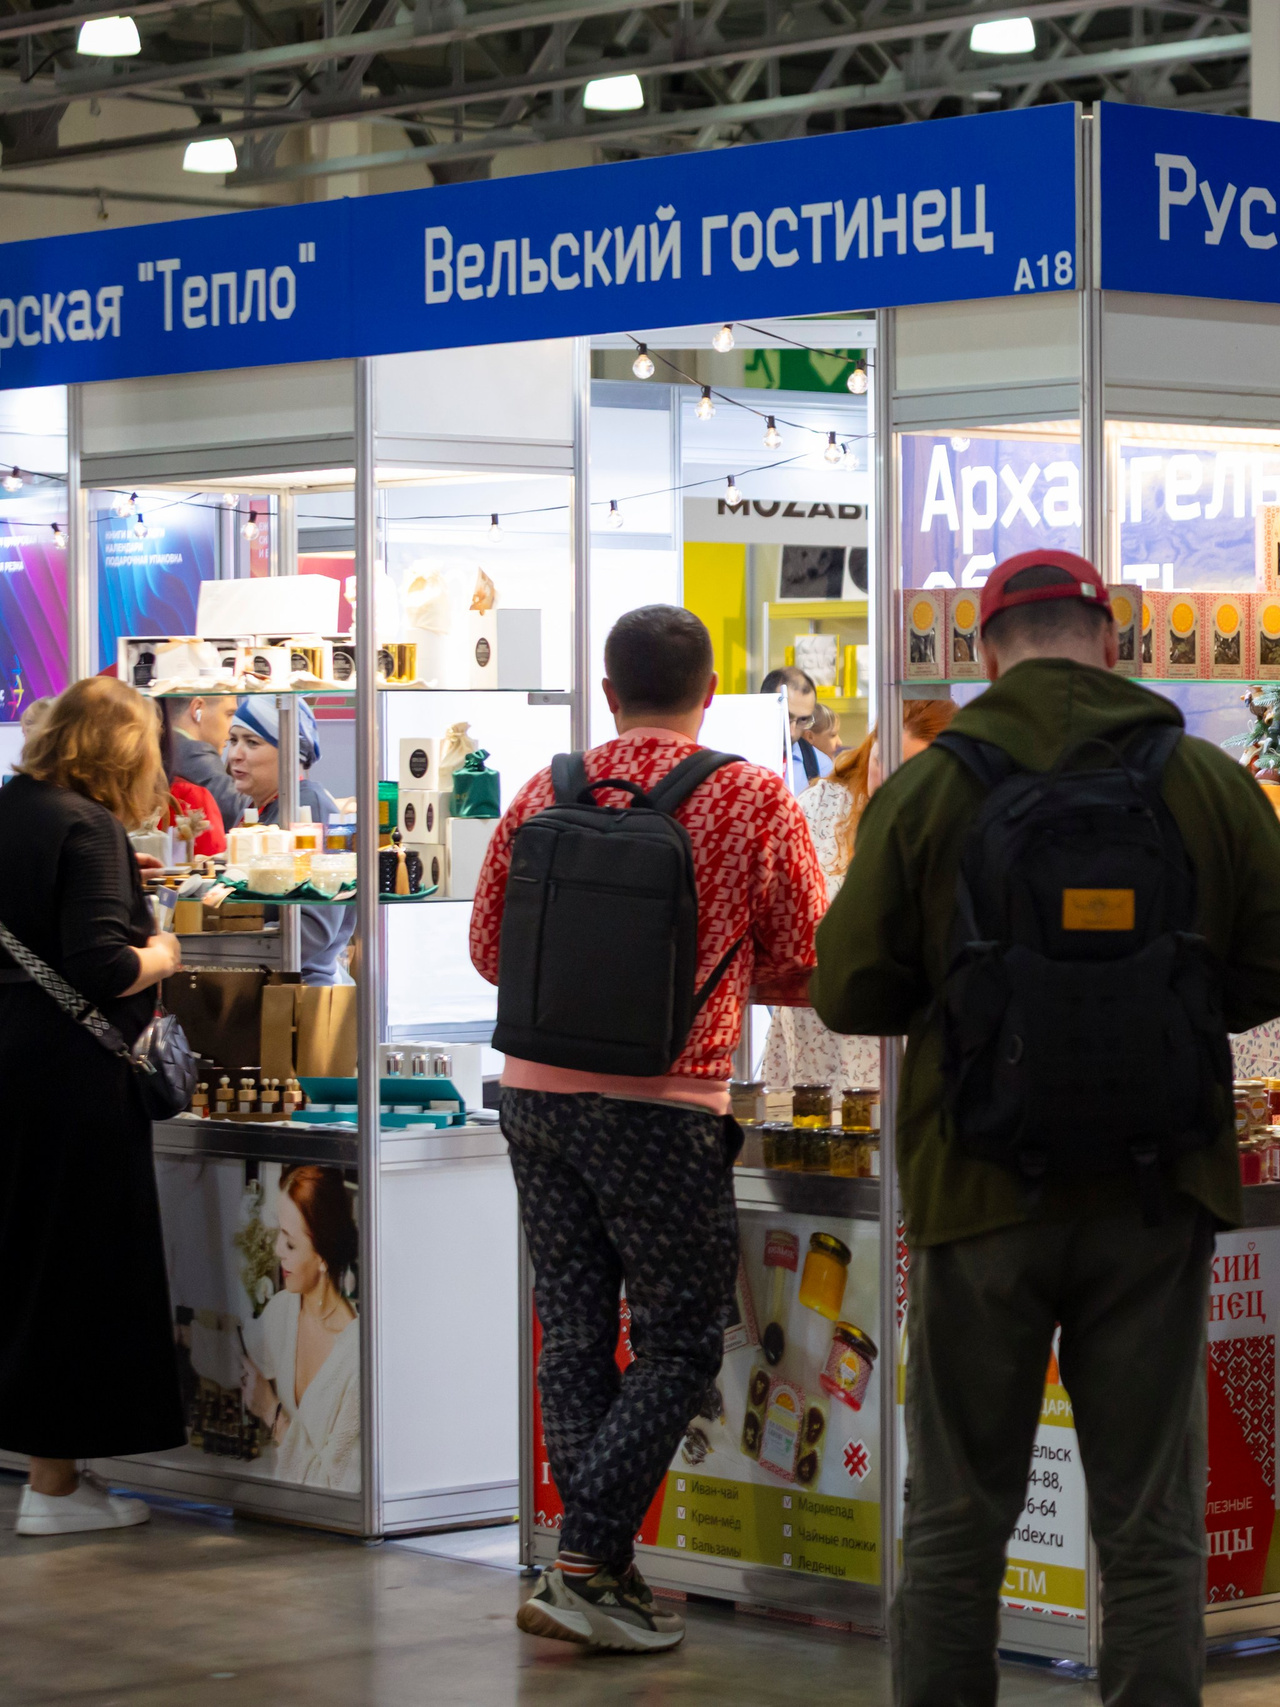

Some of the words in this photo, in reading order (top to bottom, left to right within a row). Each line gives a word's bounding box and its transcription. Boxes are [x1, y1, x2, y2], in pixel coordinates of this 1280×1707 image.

[424, 204, 682, 305] Вельский
[702, 183, 994, 276] гостинец
[1013, 250, 1074, 292] A18
[138, 242, 316, 332] "Тепло"
[105, 554, 149, 567] ПОДАРОЧНАЯ
[149, 553, 183, 565] УПАКОВКА
[691, 1479, 739, 1500] Иван-чай
[691, 1509, 742, 1531] Крем-мёд
[798, 1496, 854, 1521] Мармелад
[691, 1536, 742, 1559] Бальзамы
[799, 1526, 840, 1548] Чайные
[841, 1537, 878, 1553] ложки
[798, 1554, 847, 1577] Леденцы
